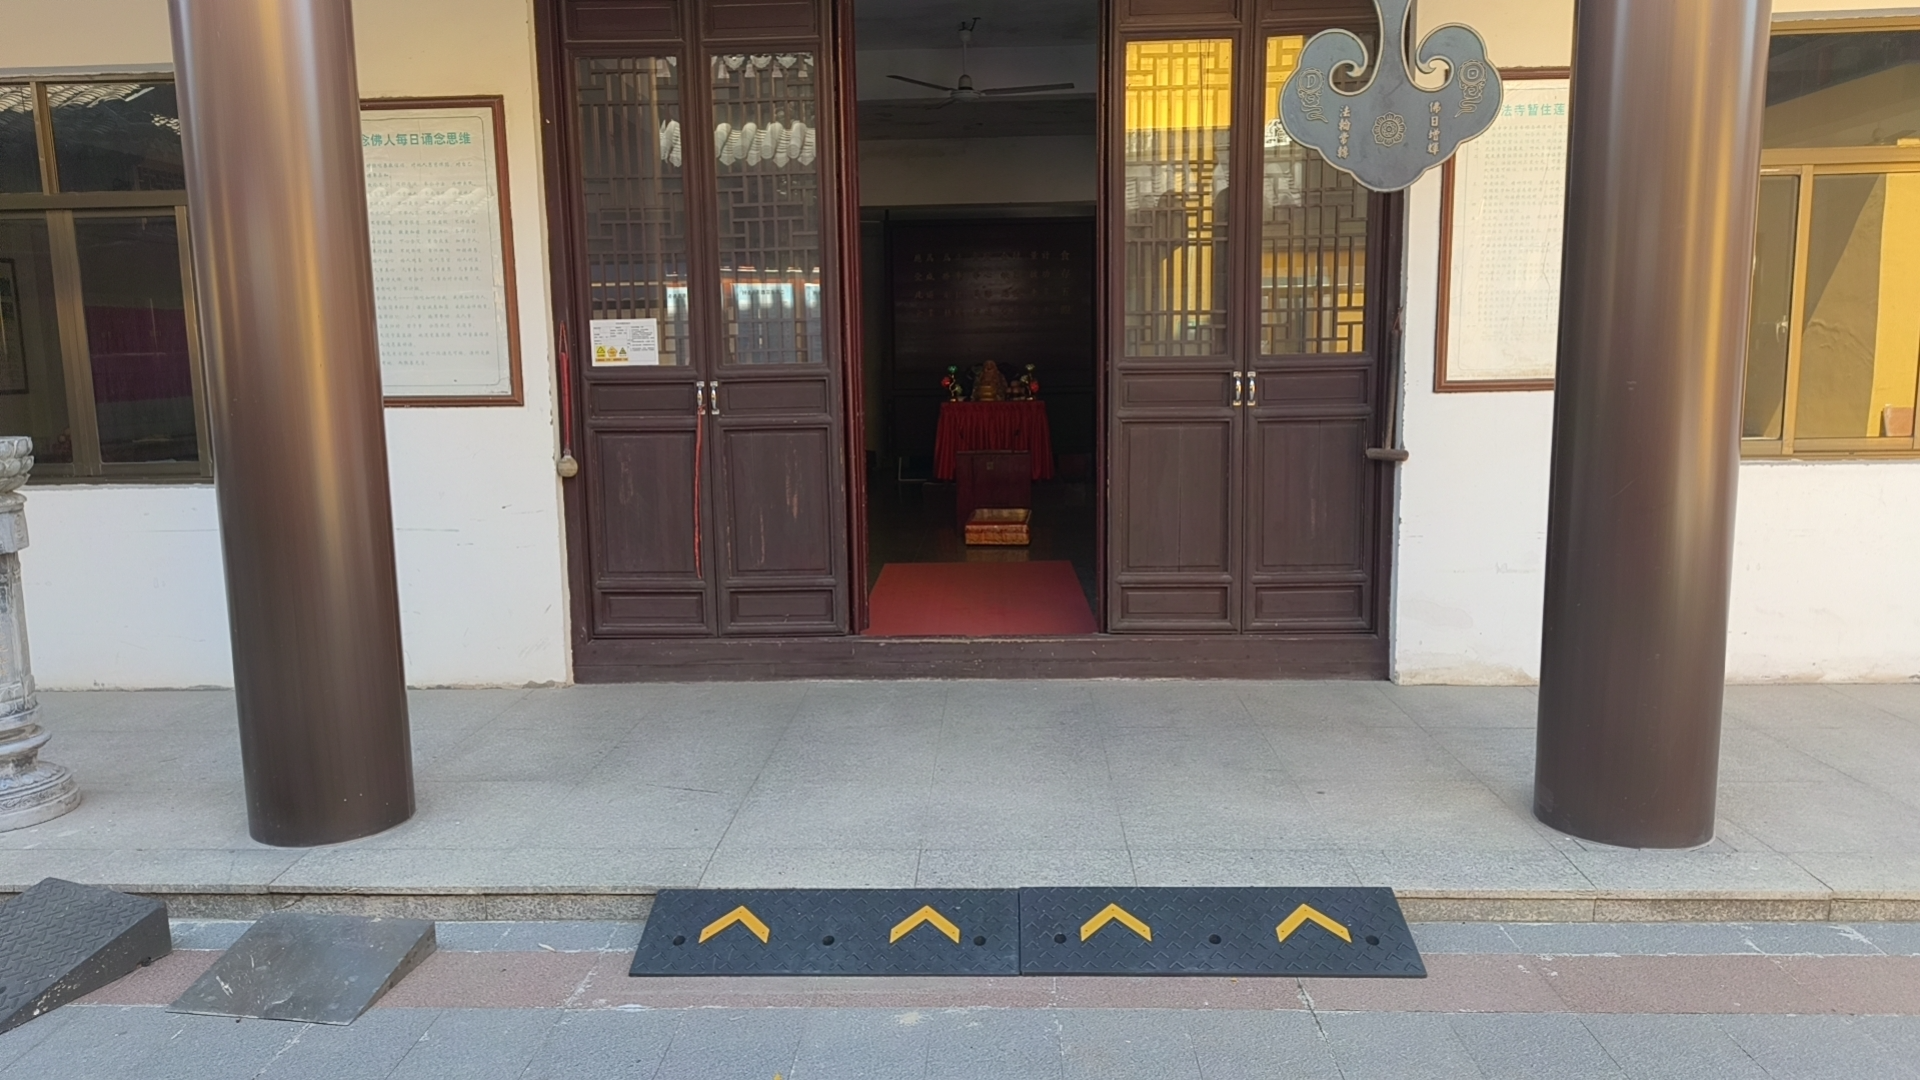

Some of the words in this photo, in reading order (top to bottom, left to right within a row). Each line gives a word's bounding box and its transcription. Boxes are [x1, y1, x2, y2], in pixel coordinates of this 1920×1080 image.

[361, 132, 471, 147] 念佛人每日诵念思维
